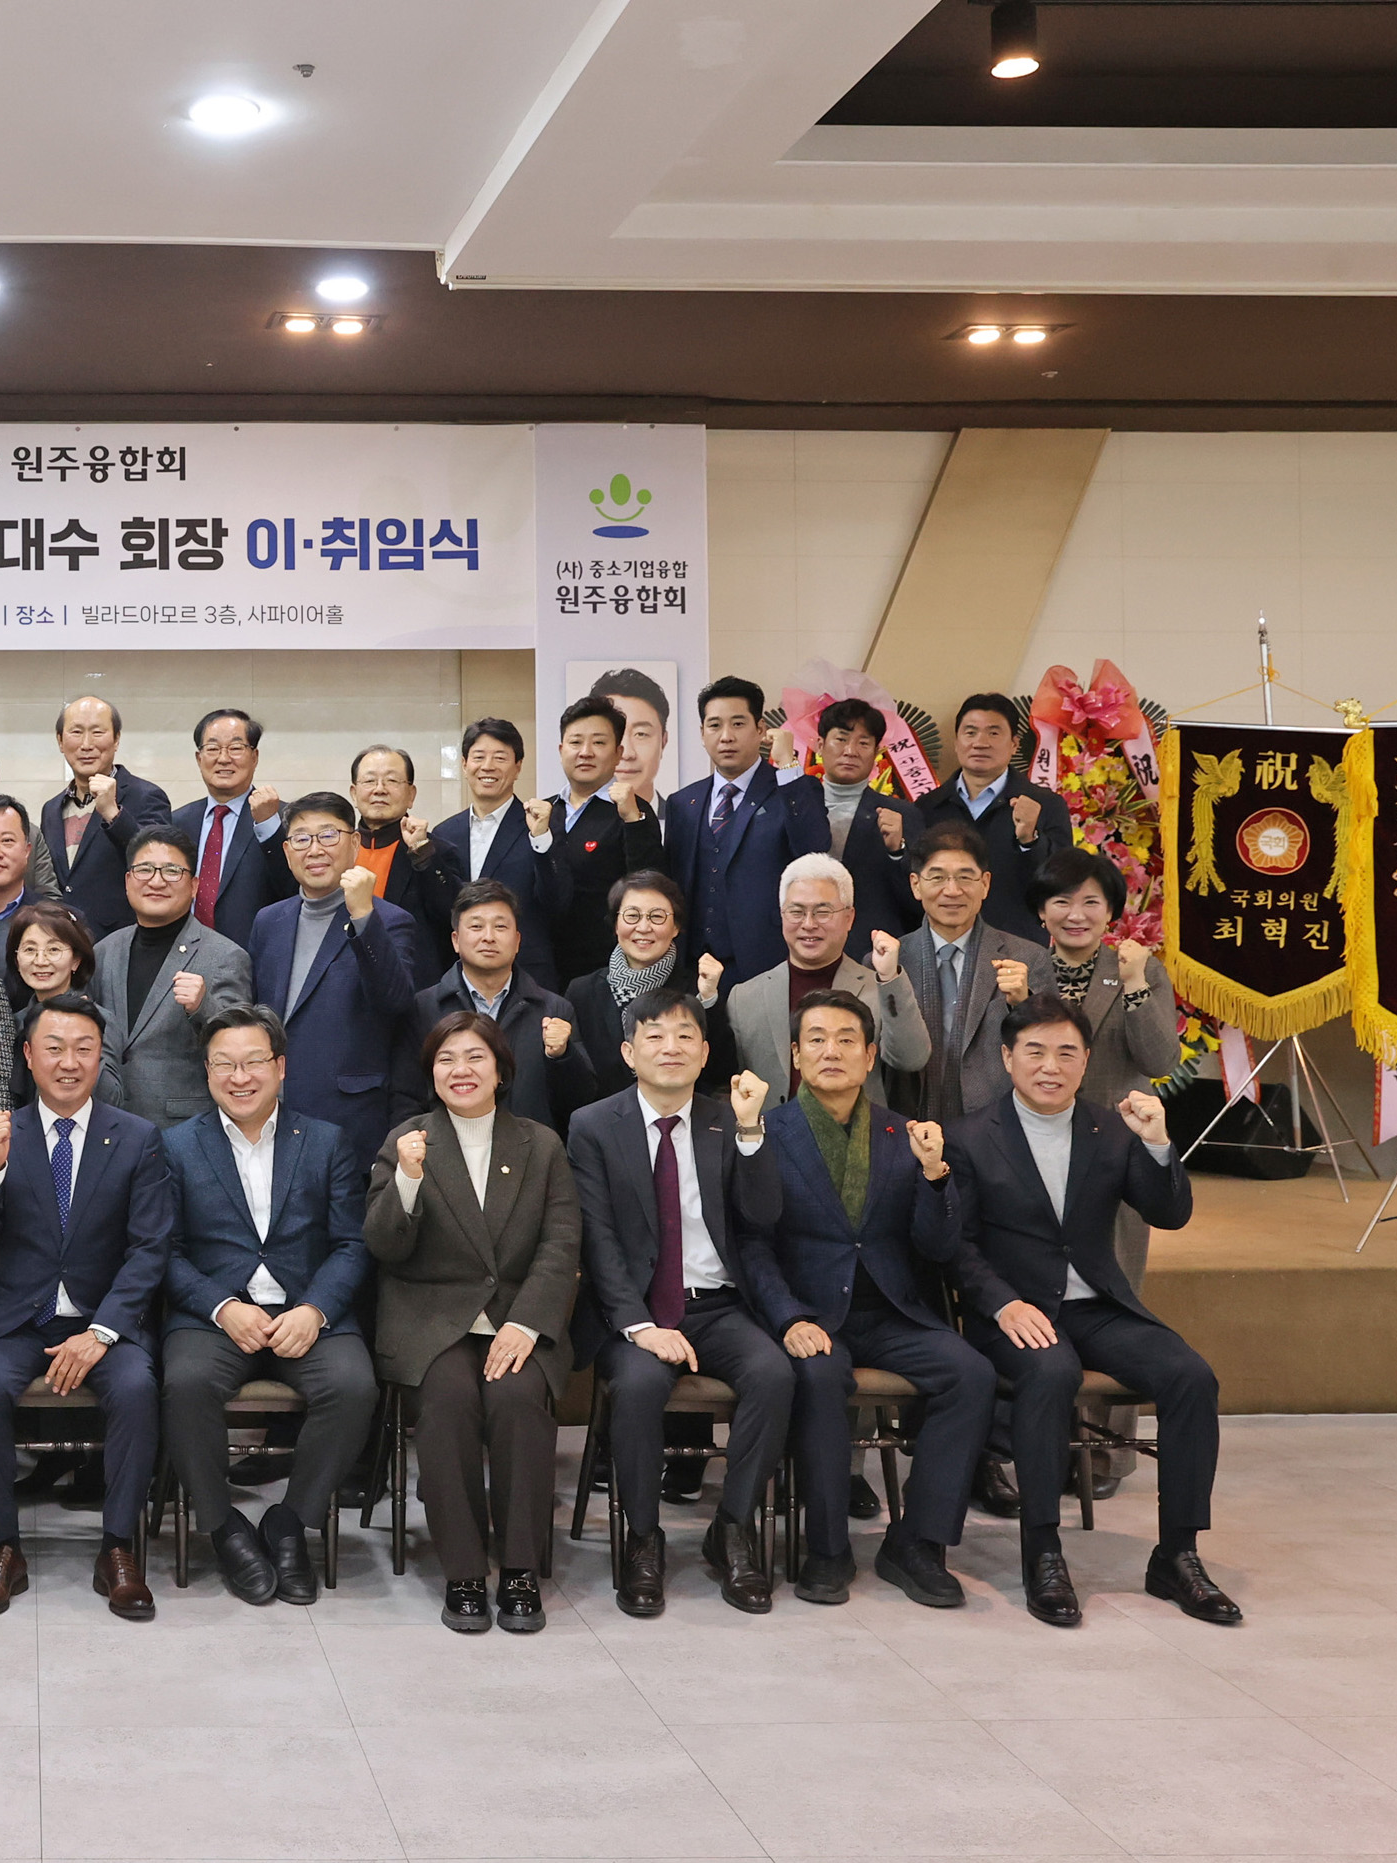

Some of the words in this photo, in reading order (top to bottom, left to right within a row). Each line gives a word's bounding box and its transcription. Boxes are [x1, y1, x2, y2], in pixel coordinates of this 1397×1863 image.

[11, 445, 187, 484] 원주융합회
[120, 516, 229, 571] 회장
[556, 560, 584, 581] (사)
[589, 559, 689, 580] 중소기업융합
[15, 605, 55, 626] 장소
[82, 604, 199, 626] 빌라드아모르
[205, 605, 242, 627] 3층,
[248, 604, 345, 625] 사파이어홀
[555, 584, 687, 616] 원주융합회
[1254, 750, 1299, 791] 祝
[1230, 889, 1319, 912] 국회의원
